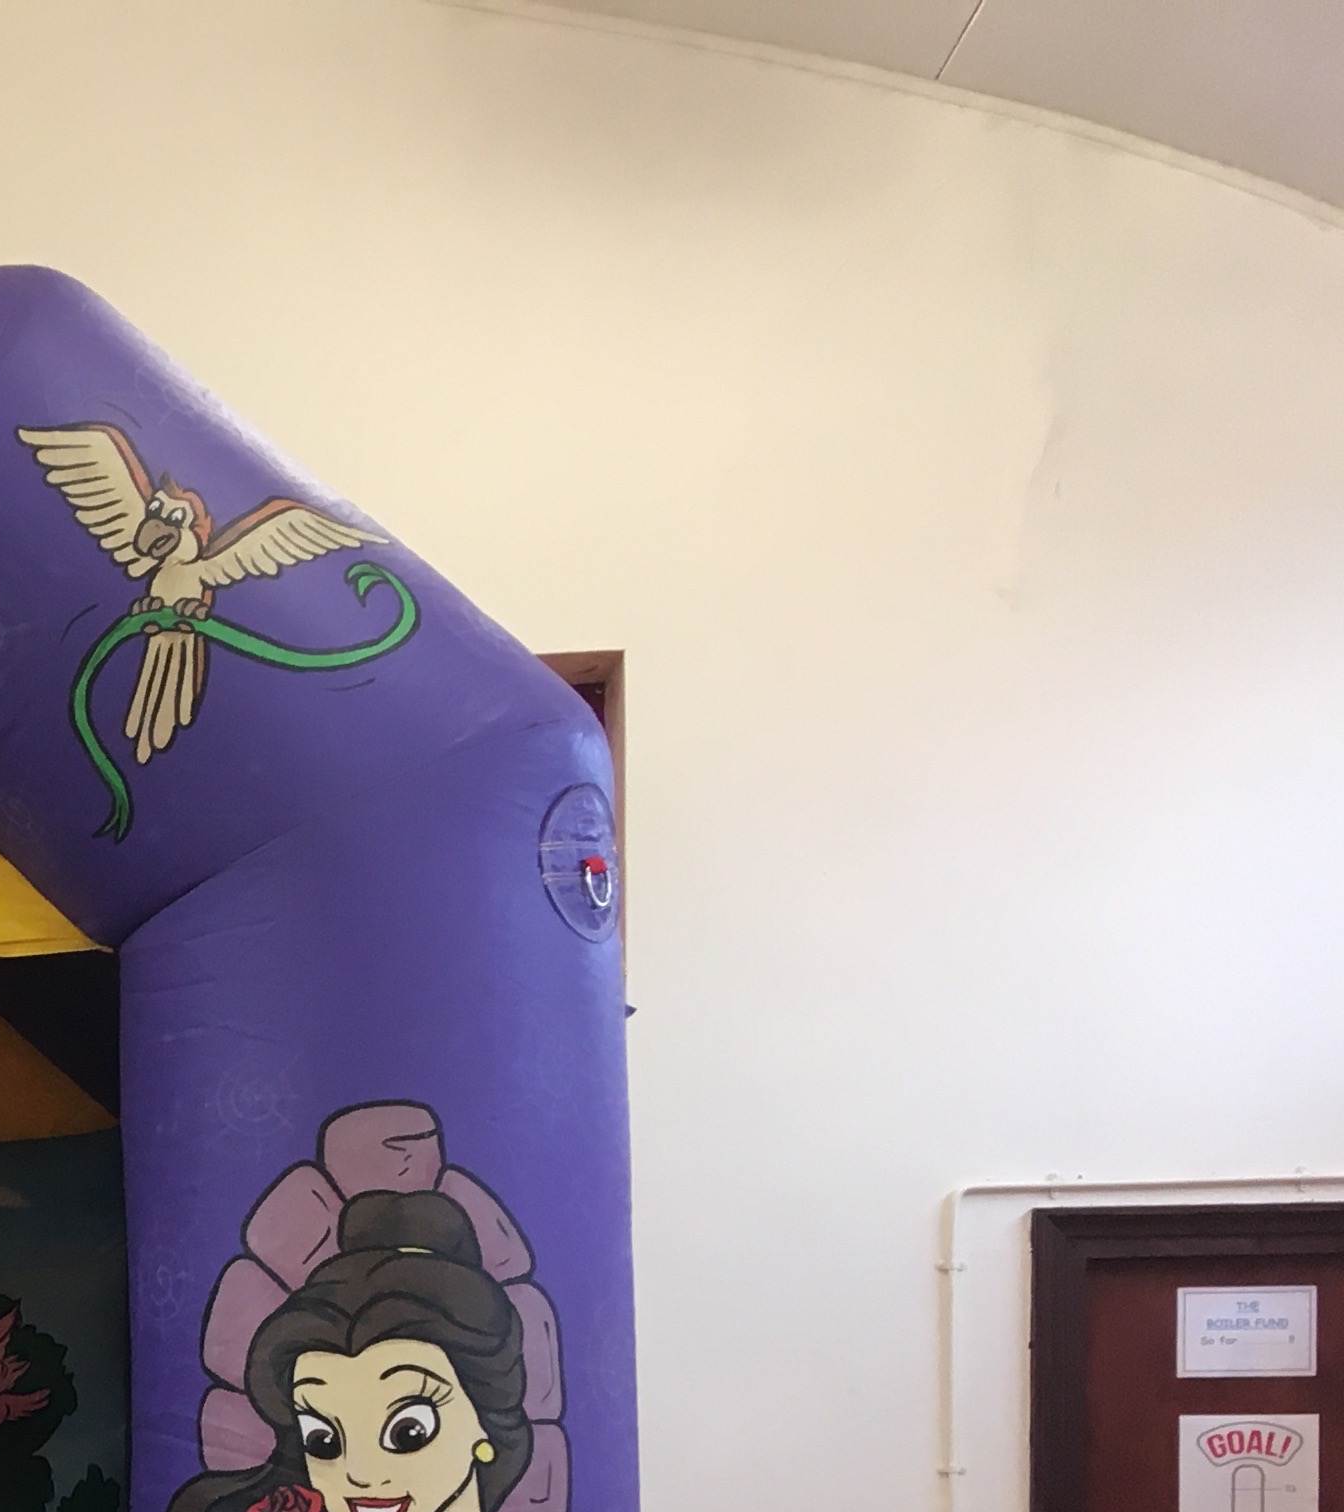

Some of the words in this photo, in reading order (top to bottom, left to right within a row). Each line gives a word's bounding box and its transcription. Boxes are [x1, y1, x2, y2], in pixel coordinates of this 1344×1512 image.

[1236, 1301, 1260, 1313] THE
[1206, 1318, 1251, 1330] BOILER
[1255, 1317, 1289, 1329] FUND
[1206, 1429, 1292, 1459] GOAL!
